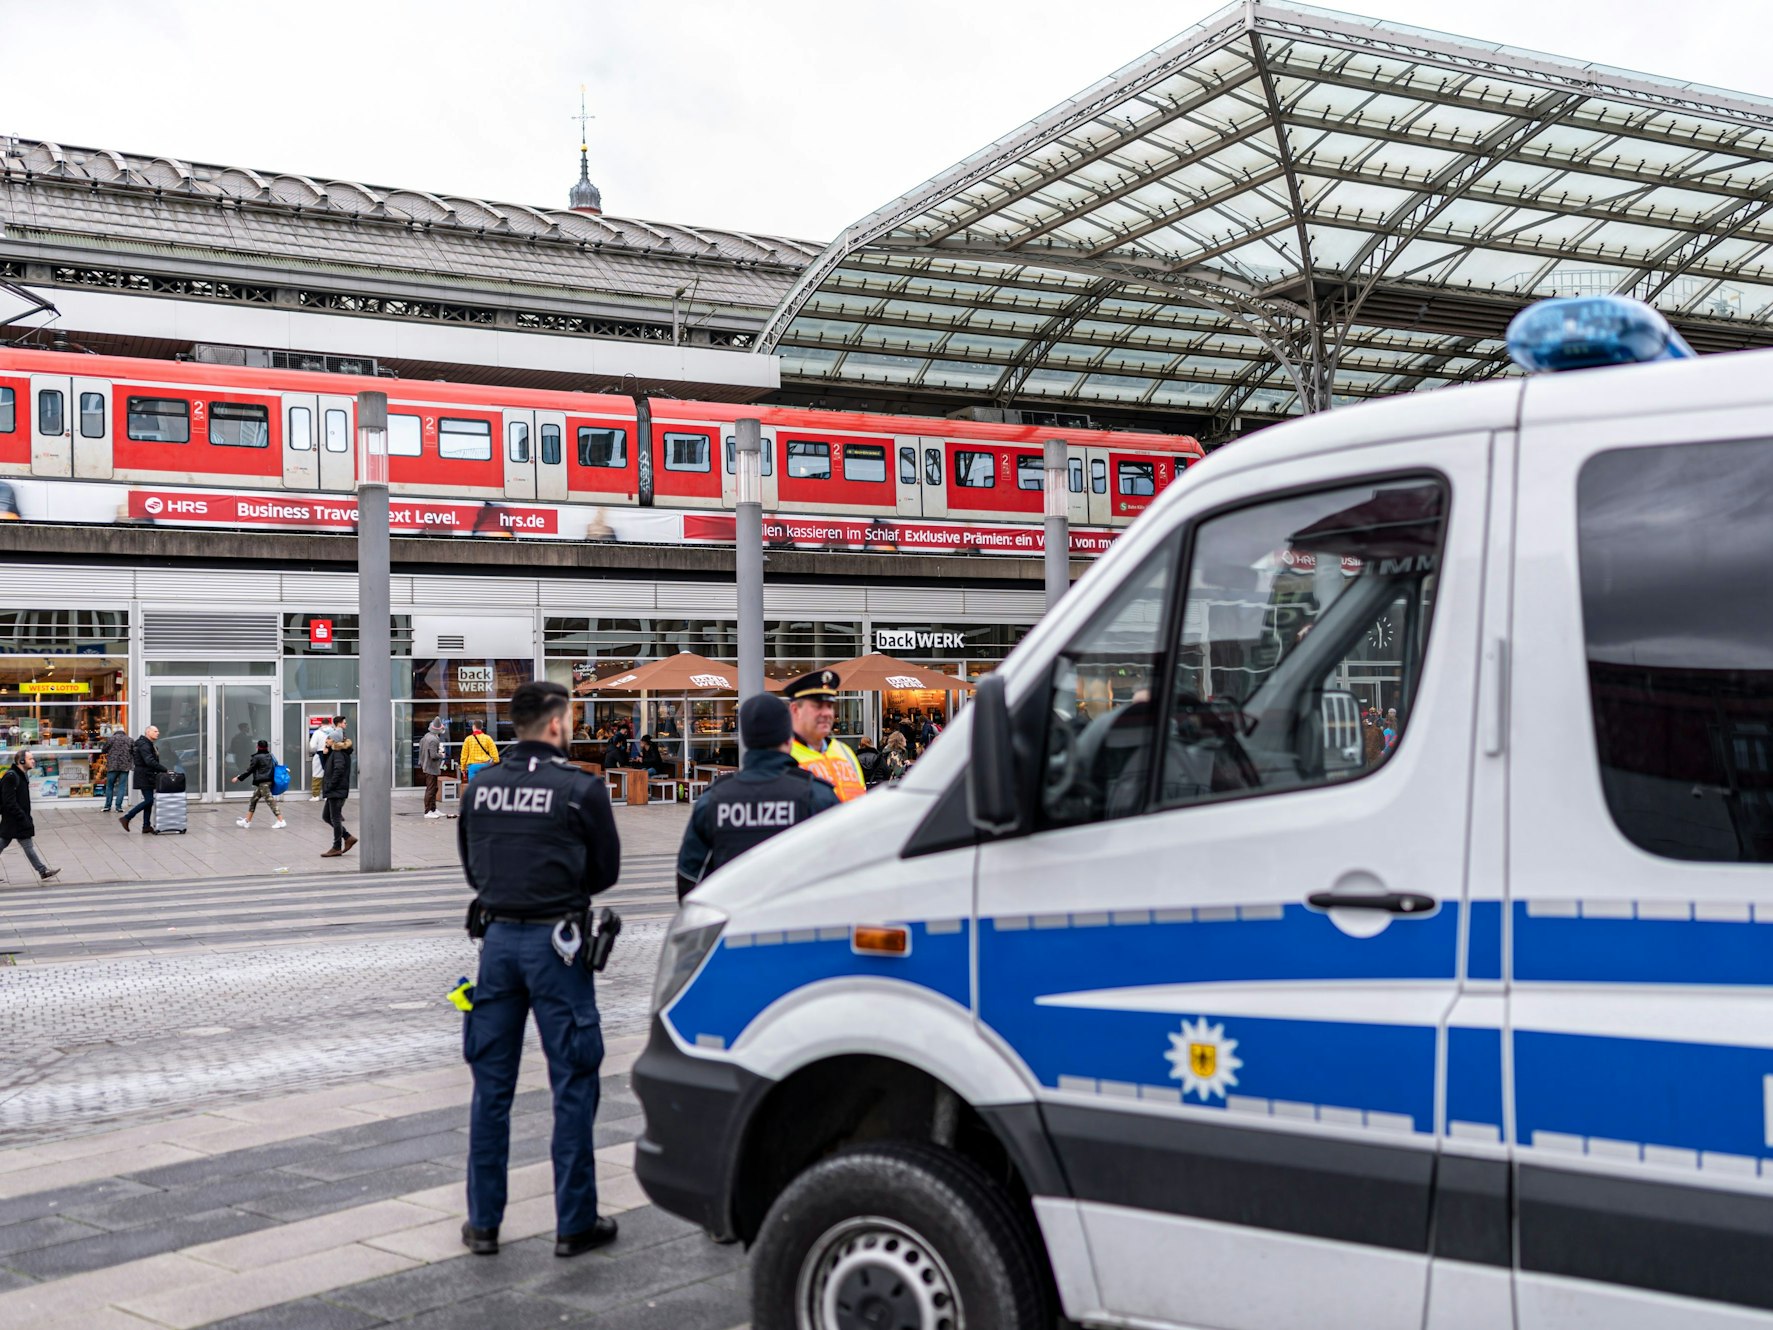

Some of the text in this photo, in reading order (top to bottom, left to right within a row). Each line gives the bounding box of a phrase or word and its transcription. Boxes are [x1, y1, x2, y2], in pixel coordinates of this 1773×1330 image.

[193, 400, 204, 415] 2
[425, 416, 435, 430] 2
[832, 443, 841, 456] 2
[1002, 453, 1009, 466] 2
[1159, 462, 1166, 475] 2
[167, 499, 208, 514] HRS
[237, 502, 460, 526] Business Trave ext Level.
[499, 512, 545, 529] hrs.de
[761, 523, 783, 537] ilen
[786, 525, 843, 540] kassieren
[846, 527, 861, 540] im
[864, 528, 902, 542] Schlaf.
[904, 529, 961, 544] Exklusive
[963, 530, 1013, 547] Prämien:
[1015, 534, 1033, 547] ein
[1074, 537, 1096, 549] von
[459, 668, 492, 680] back
[28, 684, 80, 692] WEST LOTTO
[458, 682, 494, 692] WERK
[473, 785, 554, 813] POLIZEI
[716, 801, 795, 828] POLIZEI
